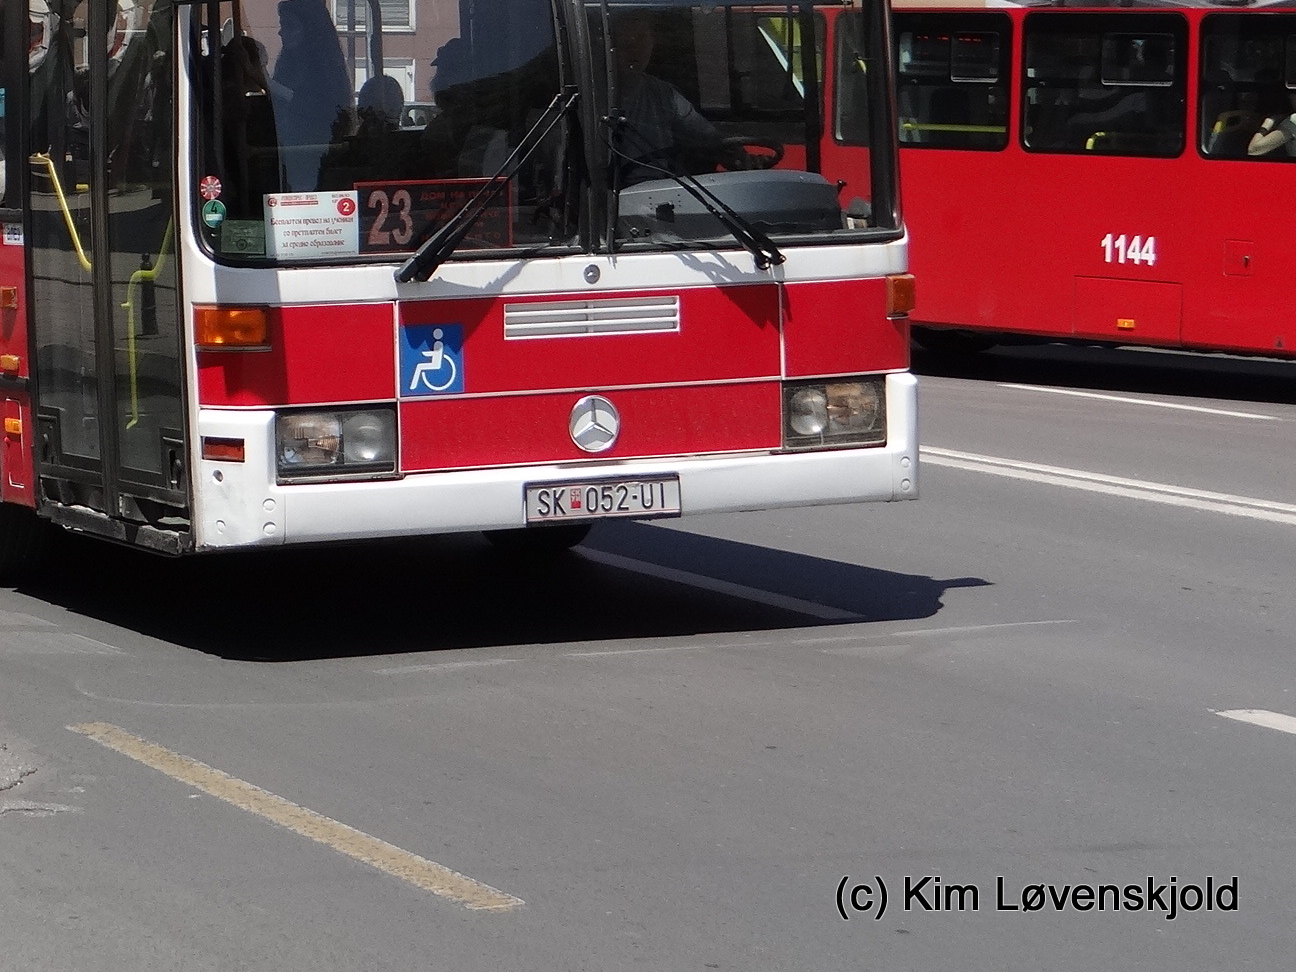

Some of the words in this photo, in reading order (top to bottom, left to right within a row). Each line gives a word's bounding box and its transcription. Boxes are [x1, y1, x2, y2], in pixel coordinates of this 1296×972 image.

[210, 202, 218, 214] 4
[342, 202, 350, 212] 2
[368, 189, 413, 245] 23
[1101, 233, 1156, 267] 1144
[537, 488, 567, 516] SK
[586, 482, 665, 512] 052-UI
